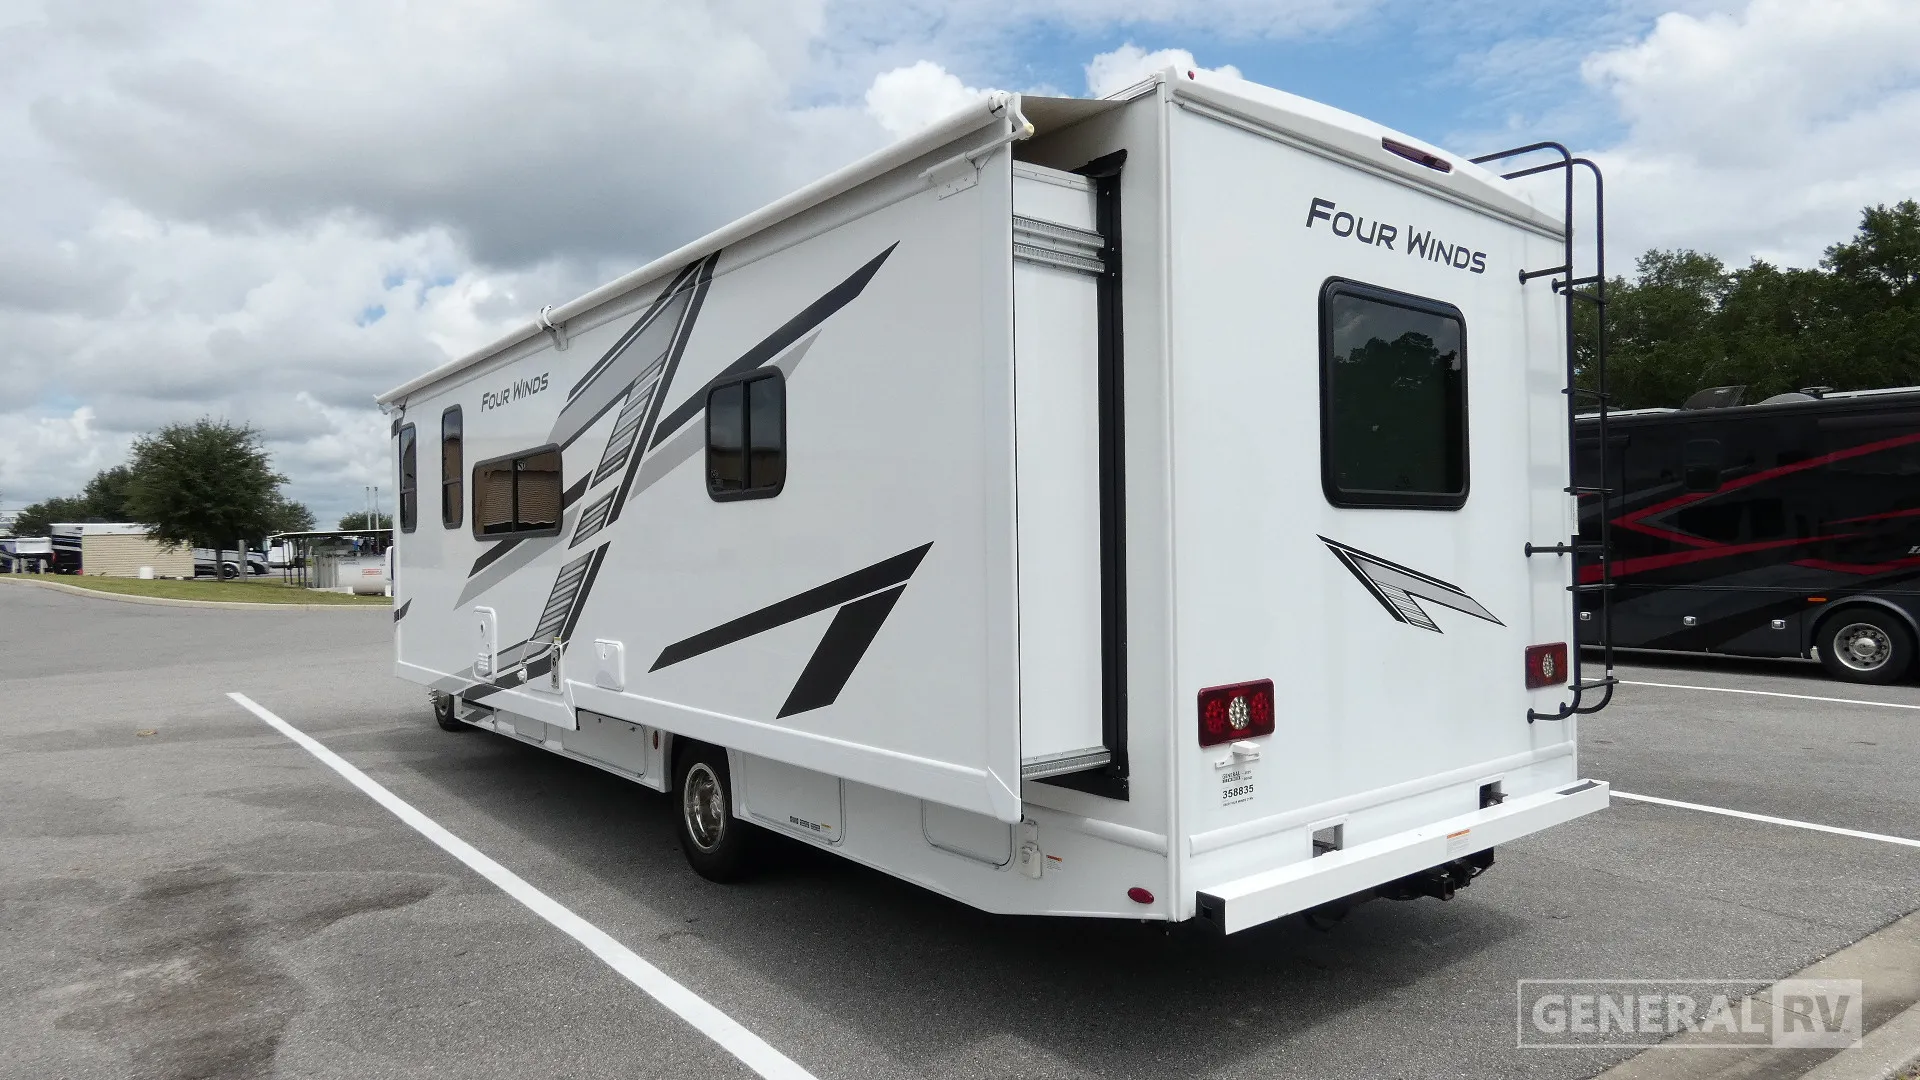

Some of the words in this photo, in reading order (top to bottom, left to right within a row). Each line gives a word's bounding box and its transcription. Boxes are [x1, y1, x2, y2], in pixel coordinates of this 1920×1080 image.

[1306, 197, 1397, 250] FOUR
[1407, 225, 1486, 274] WINDS
[481, 388, 510, 412] FOUR
[513, 372, 549, 401] WINDS
[1223, 784, 1254, 799] 358835
